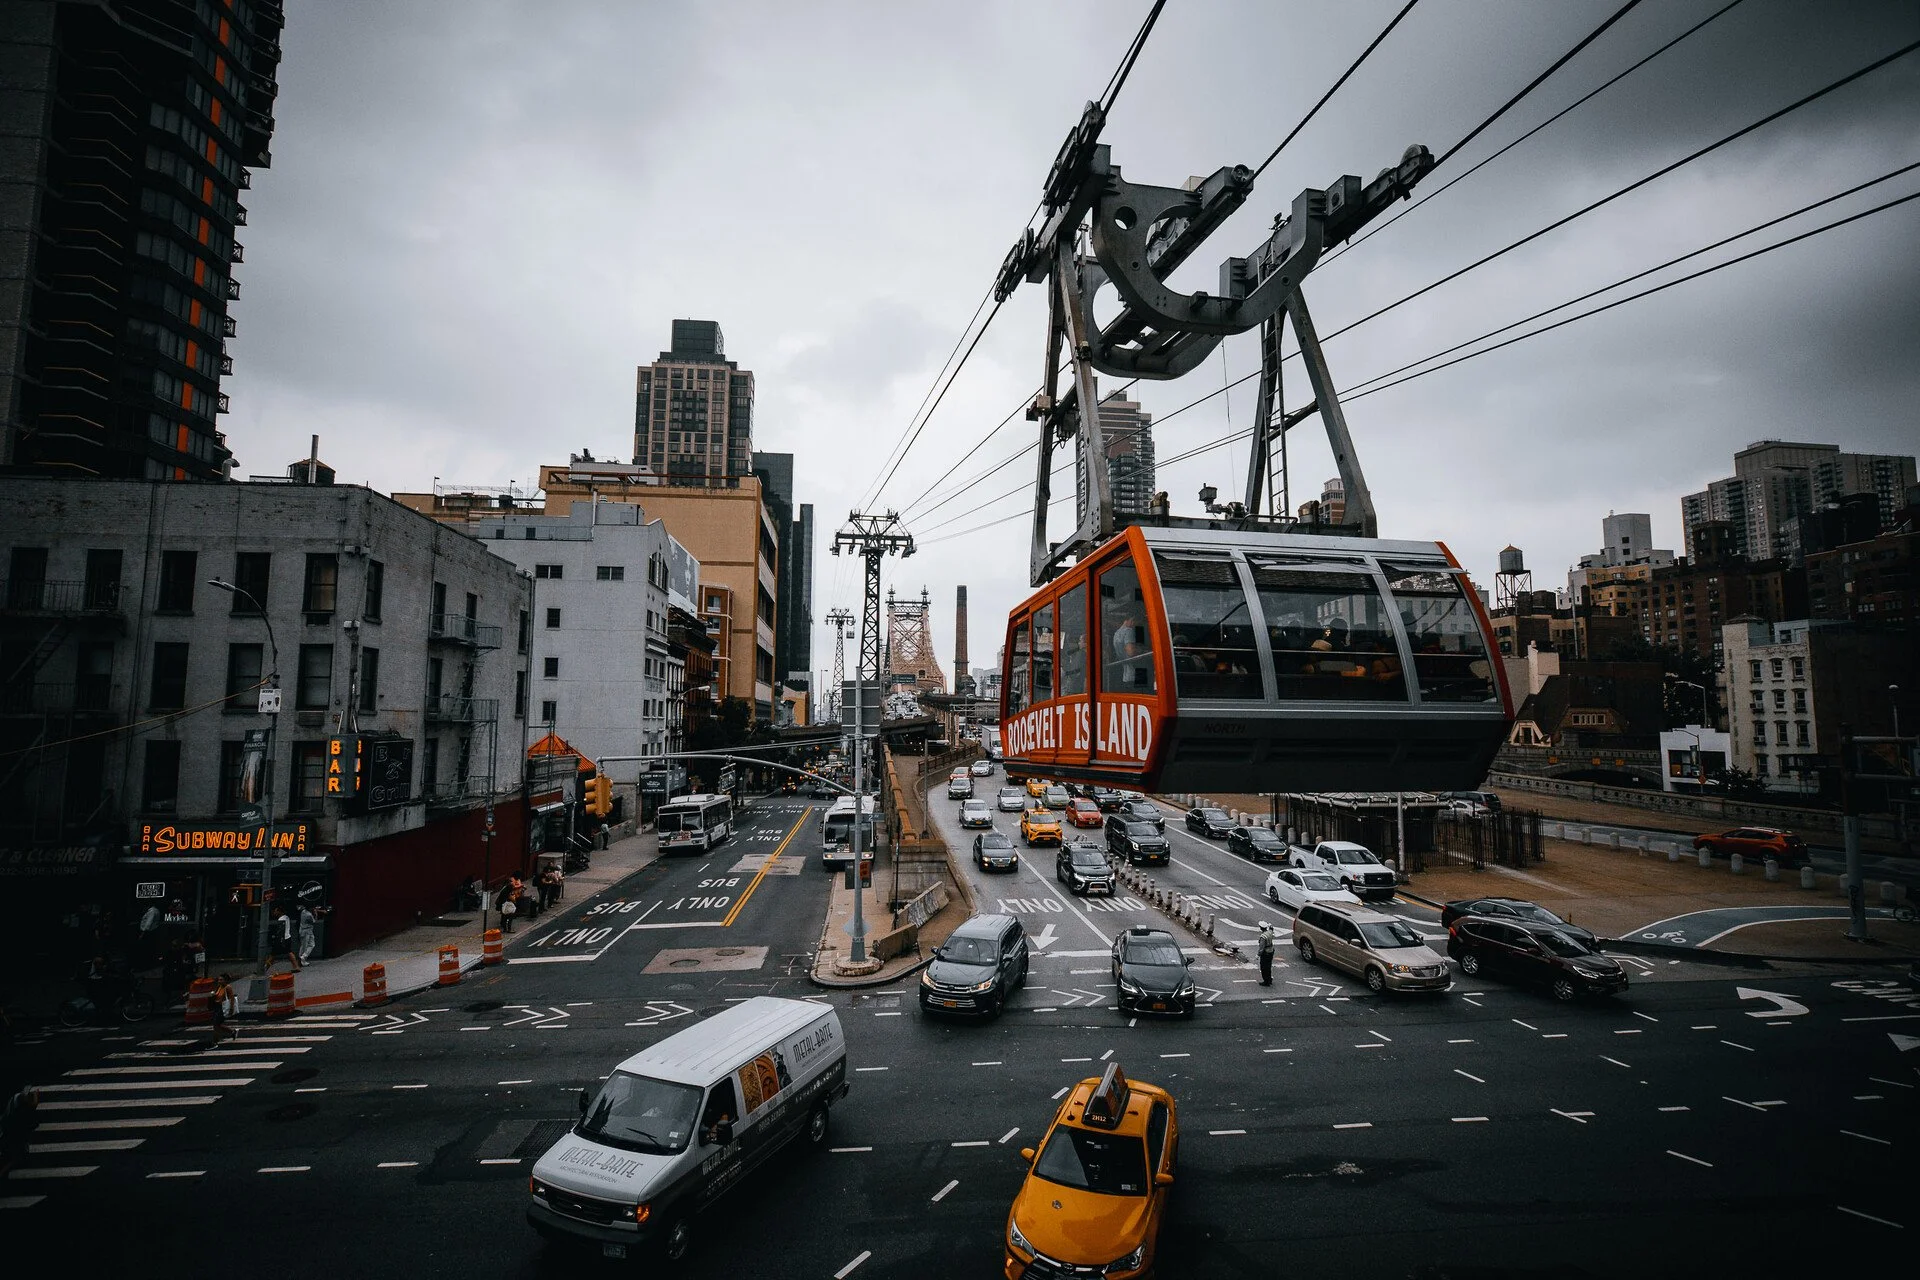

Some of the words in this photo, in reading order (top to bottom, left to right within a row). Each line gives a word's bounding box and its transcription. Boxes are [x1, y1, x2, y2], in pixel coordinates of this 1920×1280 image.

[1007, 704, 1065, 757] ROOSEVELT
[1203, 723, 1247, 735] NORTH
[327, 739, 342, 794] BAR
[370, 781, 411, 803] Grill
[142, 825, 151, 852] BAR
[153, 825, 251, 853] SUBWAY
[297, 825, 307, 852] BAR
[698, 877, 741, 888] BUS
[586, 900, 642, 916] BUS
[666, 896, 730, 910] ONLY
[997, 898, 1064, 914] ONLY
[1079, 896, 1148, 912] ONLY
[528, 927, 614, 948] ONLY
[792, 1022, 834, 1064] METAL-BRITE
[558, 1146, 645, 1179] METAL-BRITE
